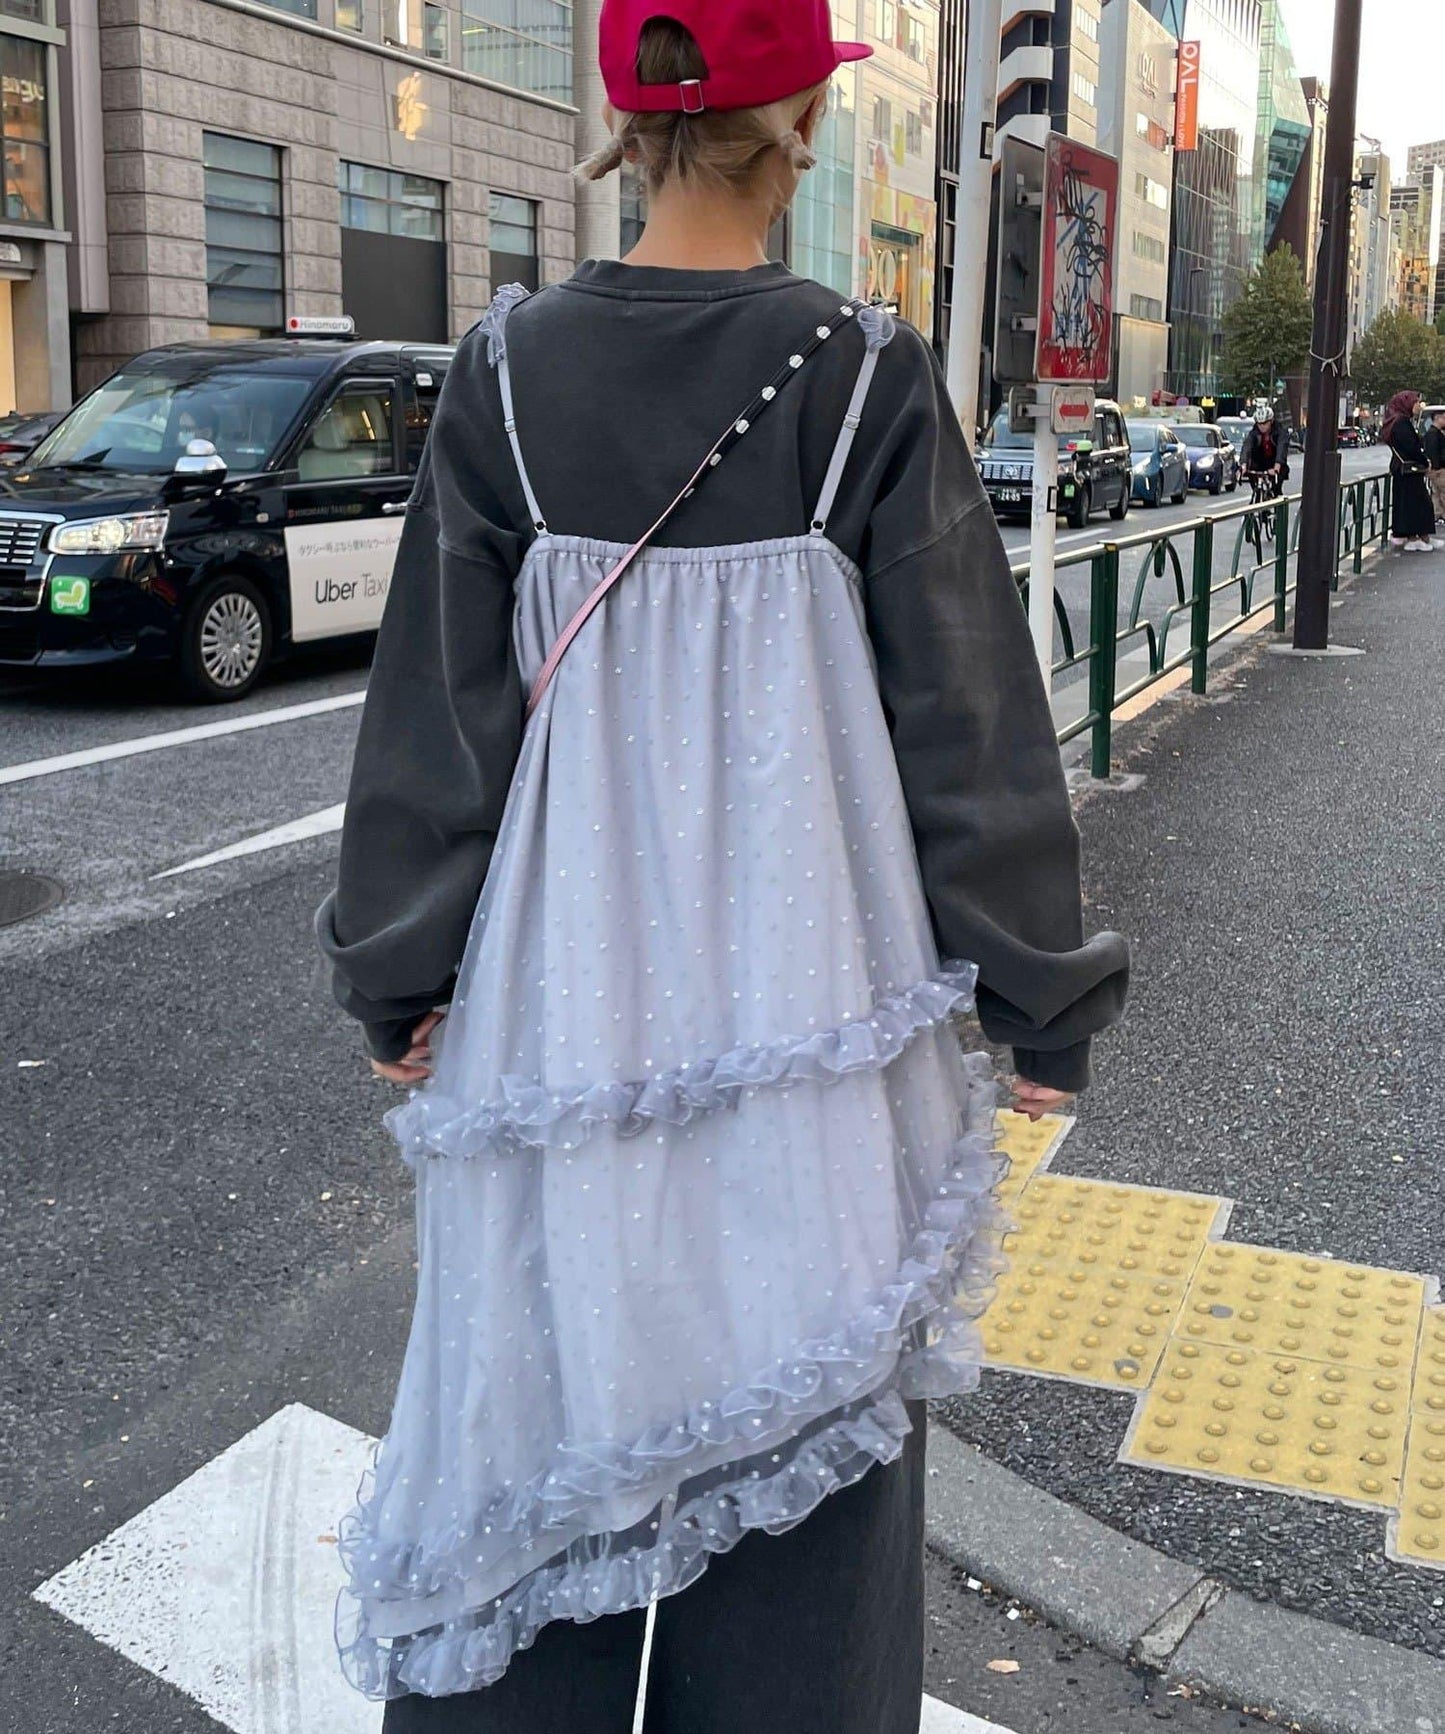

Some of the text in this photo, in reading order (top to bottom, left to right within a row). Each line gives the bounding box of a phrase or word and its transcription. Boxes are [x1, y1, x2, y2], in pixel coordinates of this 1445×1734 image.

[300, 319, 350, 330] Hinomaru
[315, 571, 389, 604] Uber Taxi
